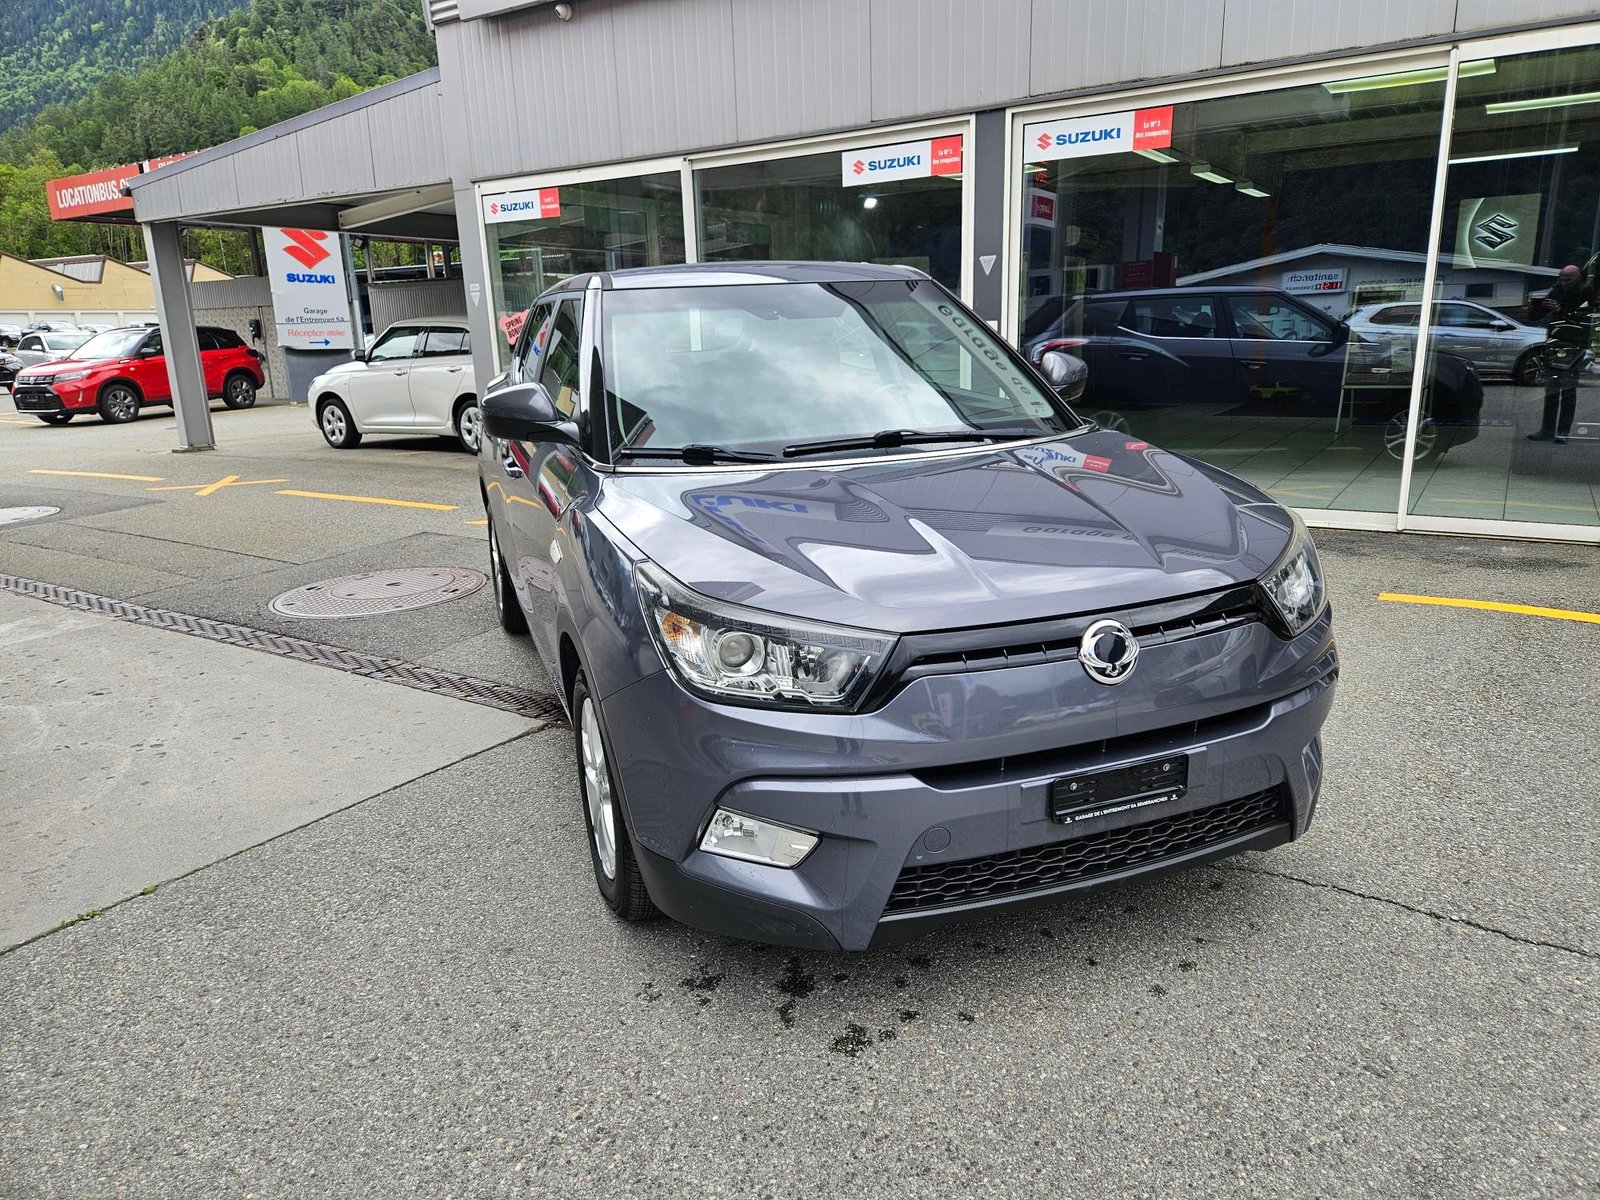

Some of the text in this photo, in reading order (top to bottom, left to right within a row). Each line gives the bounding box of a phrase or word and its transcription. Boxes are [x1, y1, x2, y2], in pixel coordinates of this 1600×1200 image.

[1055, 127, 1121, 146] SUZUKI
[868, 155, 921, 171] SUZUKI
[56, 177, 132, 208] LOCATIONBUS.C
[500, 201, 534, 212] SUZUKI
[286, 272, 336, 284] SUZUKI
[303, 307, 328, 316] Garage
[505, 316, 523, 330] SPRING
[287, 328, 325, 337] Réception
[1075, 812, 1094, 821] GARAGE
